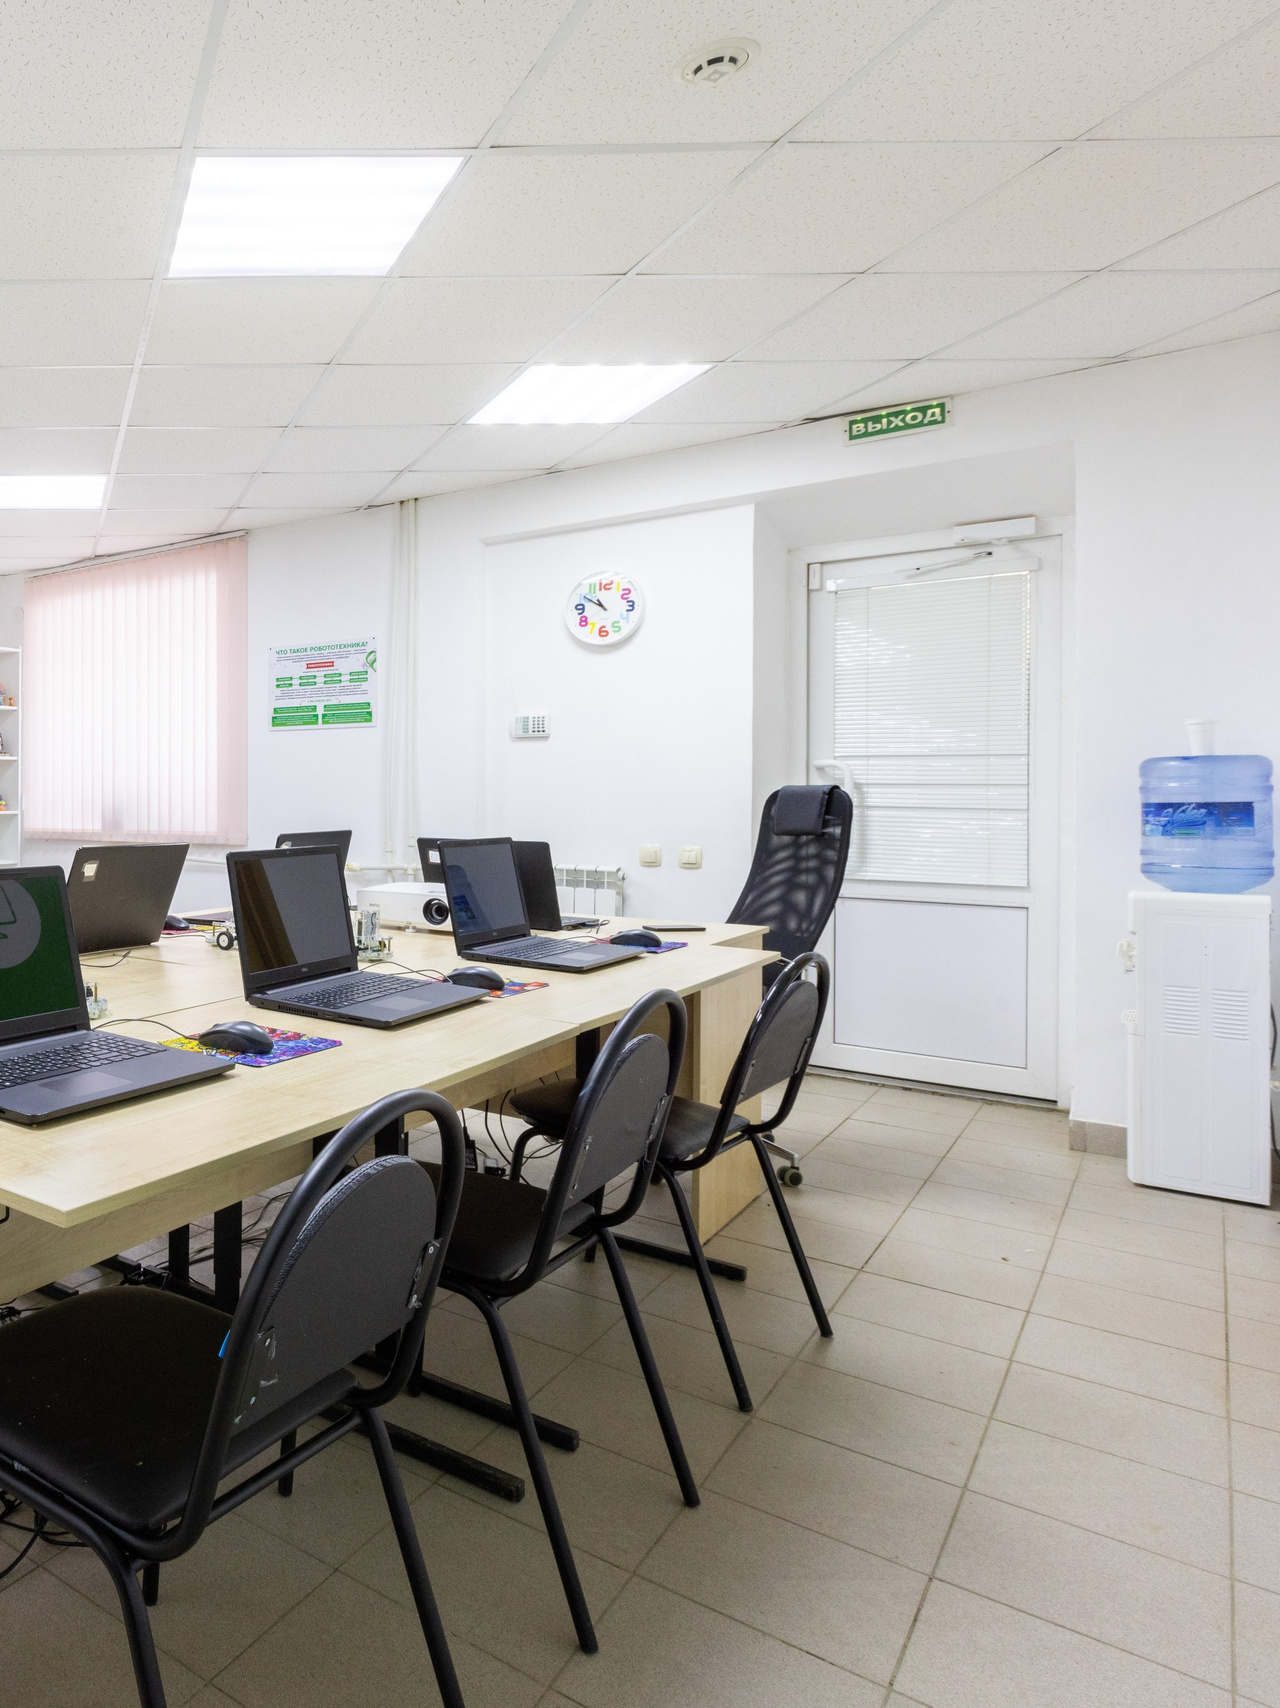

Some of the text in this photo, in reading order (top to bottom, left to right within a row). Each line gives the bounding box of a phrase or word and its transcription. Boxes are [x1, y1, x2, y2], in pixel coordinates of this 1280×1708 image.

[851, 408, 942, 435] ВЫХОД
[599, 579, 614, 591] 12
[616, 581, 620, 592] 1
[621, 588, 631, 600] 2
[575, 603, 585, 615] 9
[626, 600, 635, 612] 3
[579, 615, 588, 627] 8
[620, 612, 629, 623] 4
[588, 622, 596, 634] 7
[598, 625, 609, 637] 6
[611, 621, 621, 633] 5
[289, 646, 309, 654] ТАКОЕ
[309, 641, 368, 652] РОБОТОТЕХНИКА?
